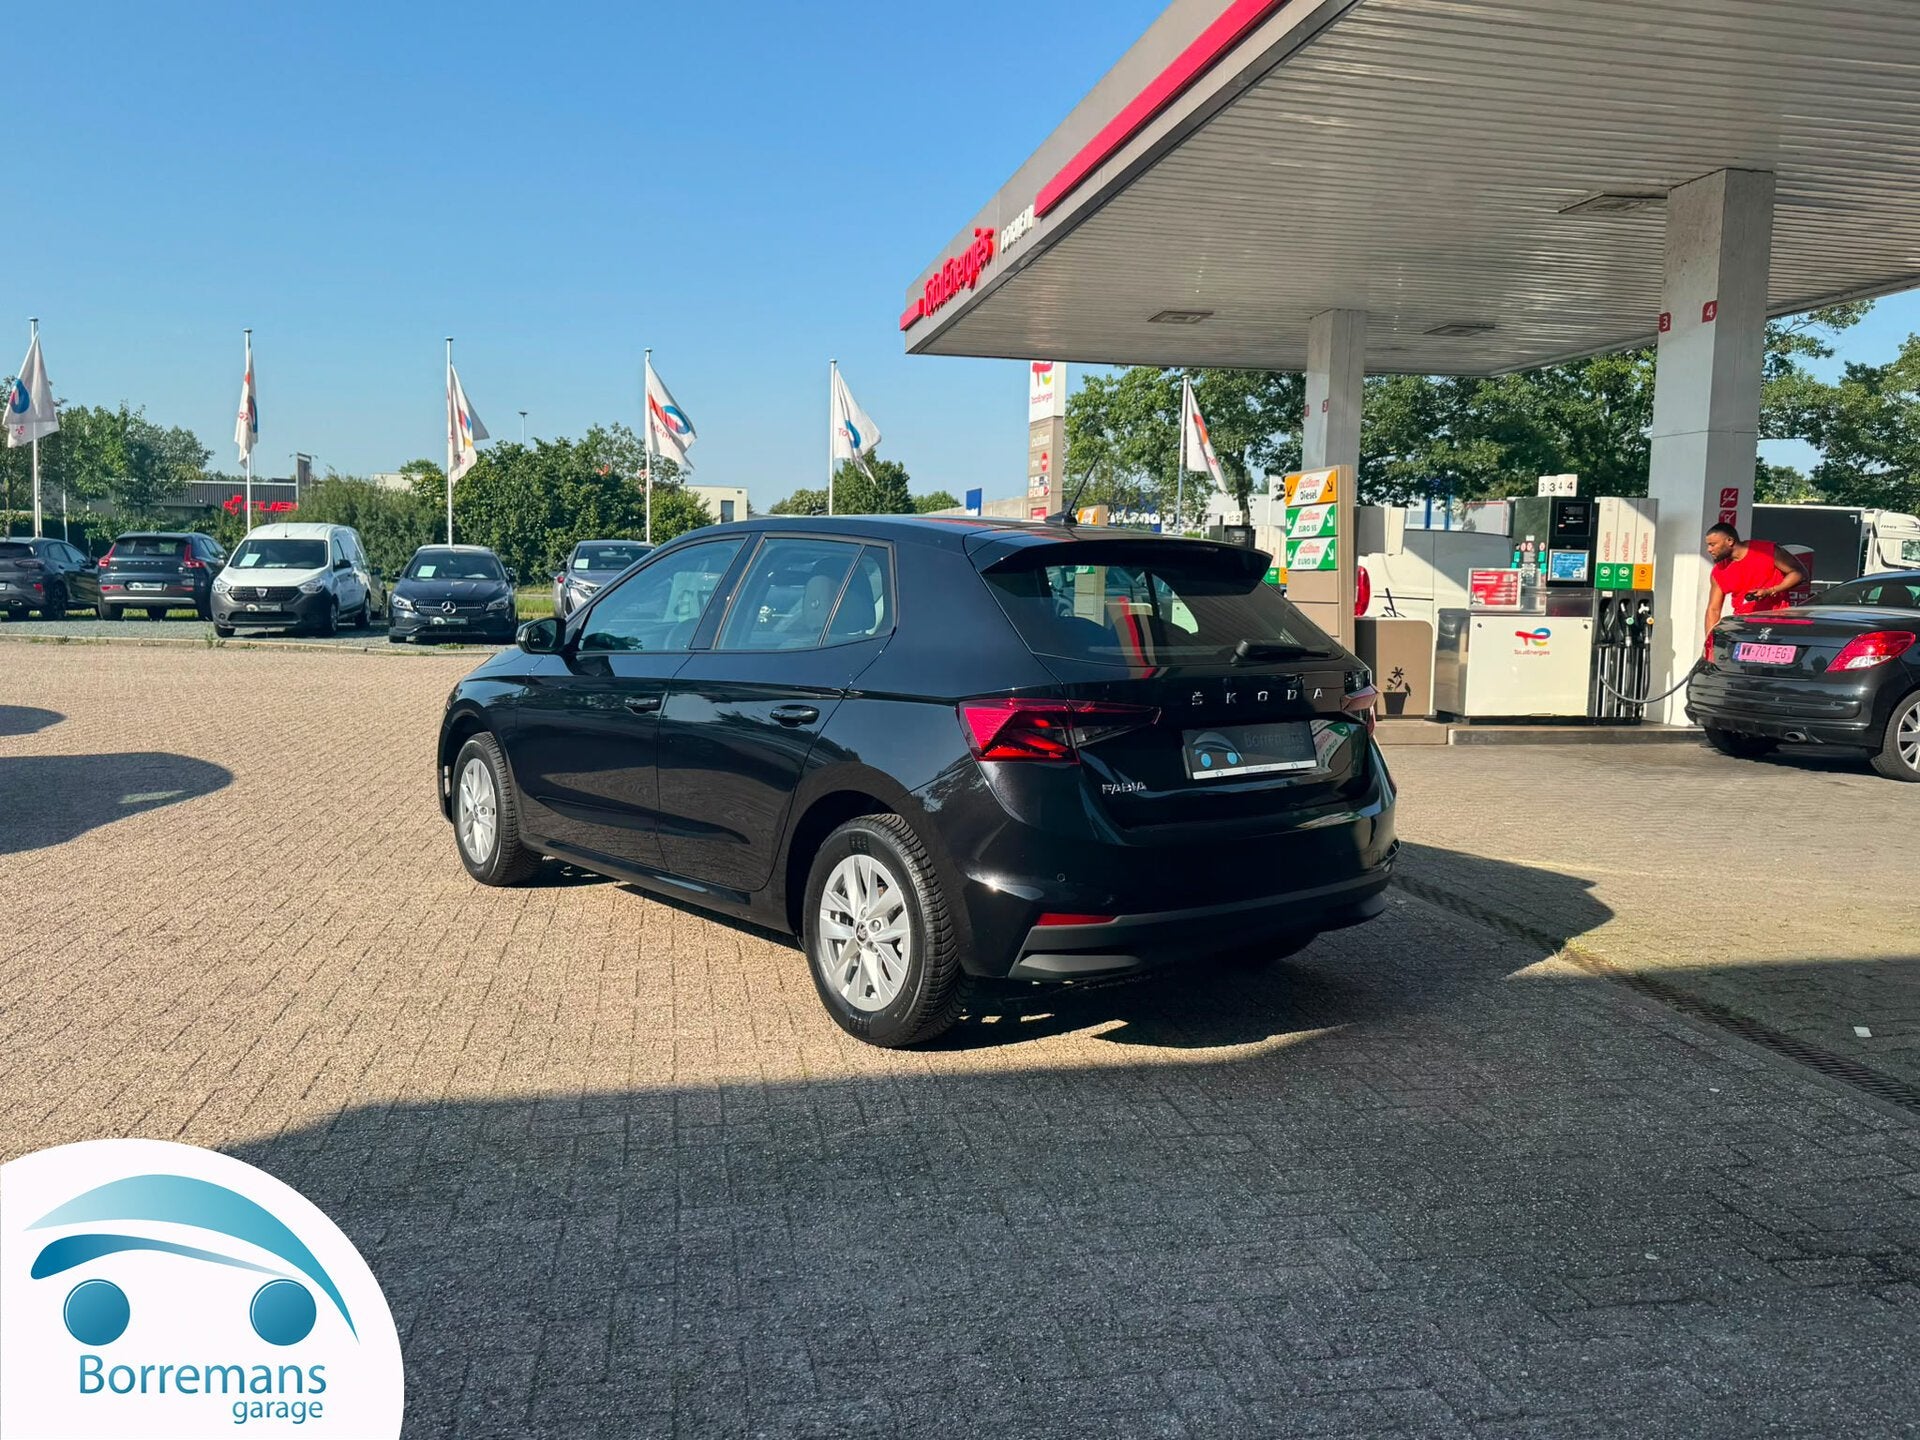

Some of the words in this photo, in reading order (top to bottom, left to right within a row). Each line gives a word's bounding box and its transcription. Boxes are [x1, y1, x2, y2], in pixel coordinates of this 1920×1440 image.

[924, 228, 994, 317] TotalEnergies
[1706, 304, 1713, 318] 4
[1662, 316, 1668, 329] 3
[1549, 482, 1556, 492] 3
[1567, 481, 1573, 490] 4
[1300, 489, 1318, 500] Diesel
[1191, 687, 1324, 706] ŠKODA
[1102, 781, 1147, 795] FABIA
